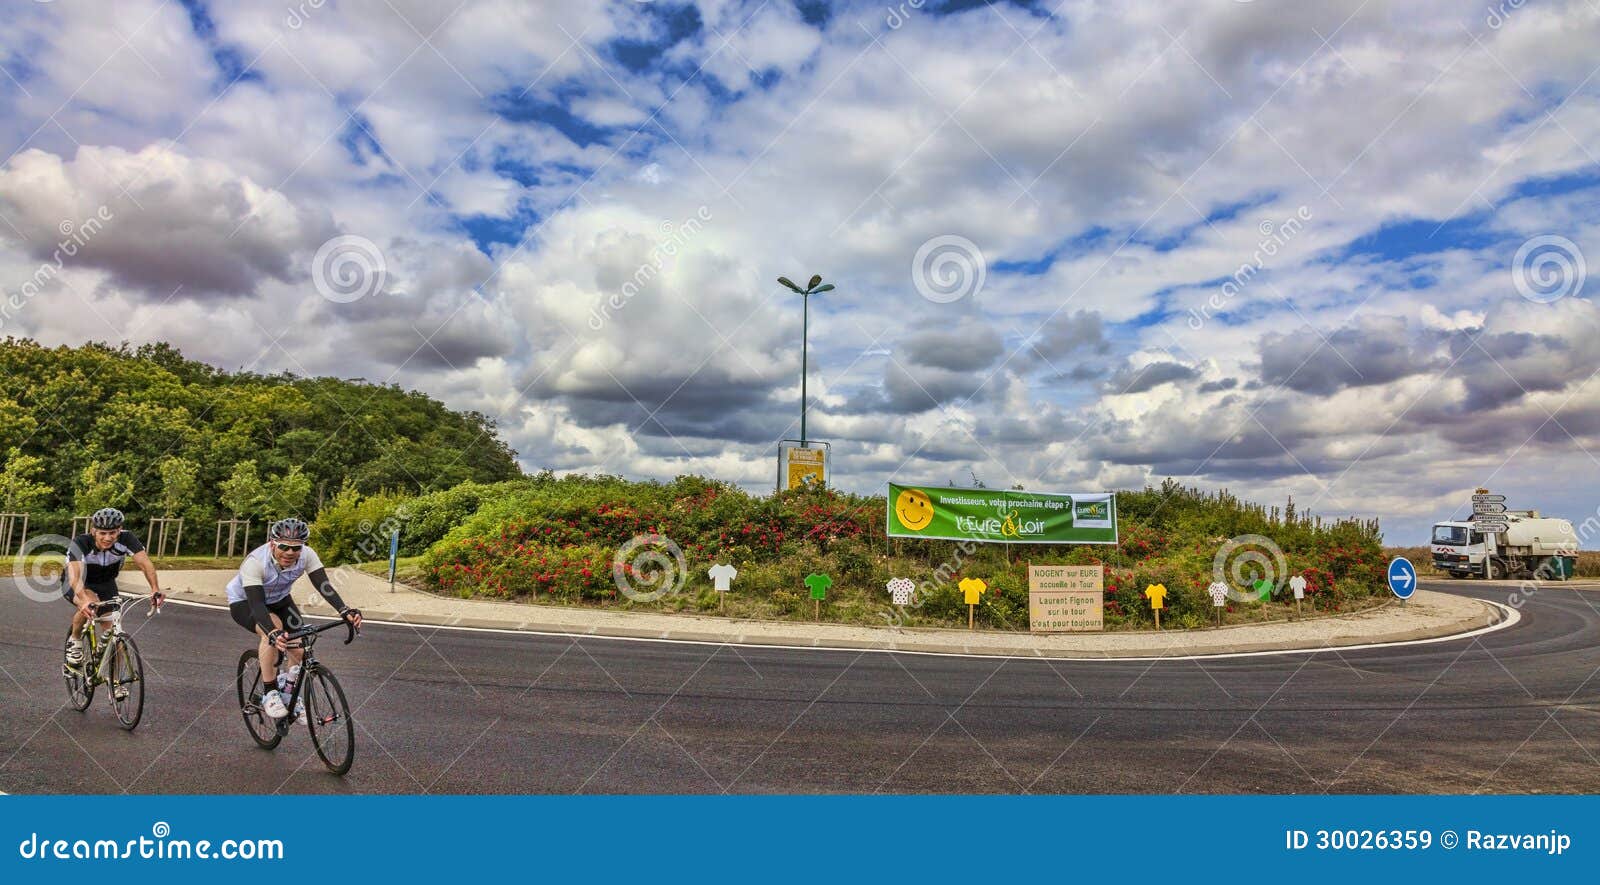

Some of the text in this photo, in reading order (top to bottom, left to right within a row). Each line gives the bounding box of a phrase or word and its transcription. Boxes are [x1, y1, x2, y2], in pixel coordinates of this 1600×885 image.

[940, 496, 988, 507] Investisseurs,
[989, 498, 1007, 507] votre
[1008, 499, 1042, 509] prochaine
[1044, 499, 1063, 510] étape
[1034, 569, 1064, 577] NOGENT
[1080, 569, 1099, 577] EURE
[1040, 580, 1094, 588] accueille le Tour
[1039, 596, 1094, 605] Laurent Fignon
[1062, 608, 1069, 616] le
[1071, 608, 1087, 616] tour
[1071, 618, 1101, 627] toujours
